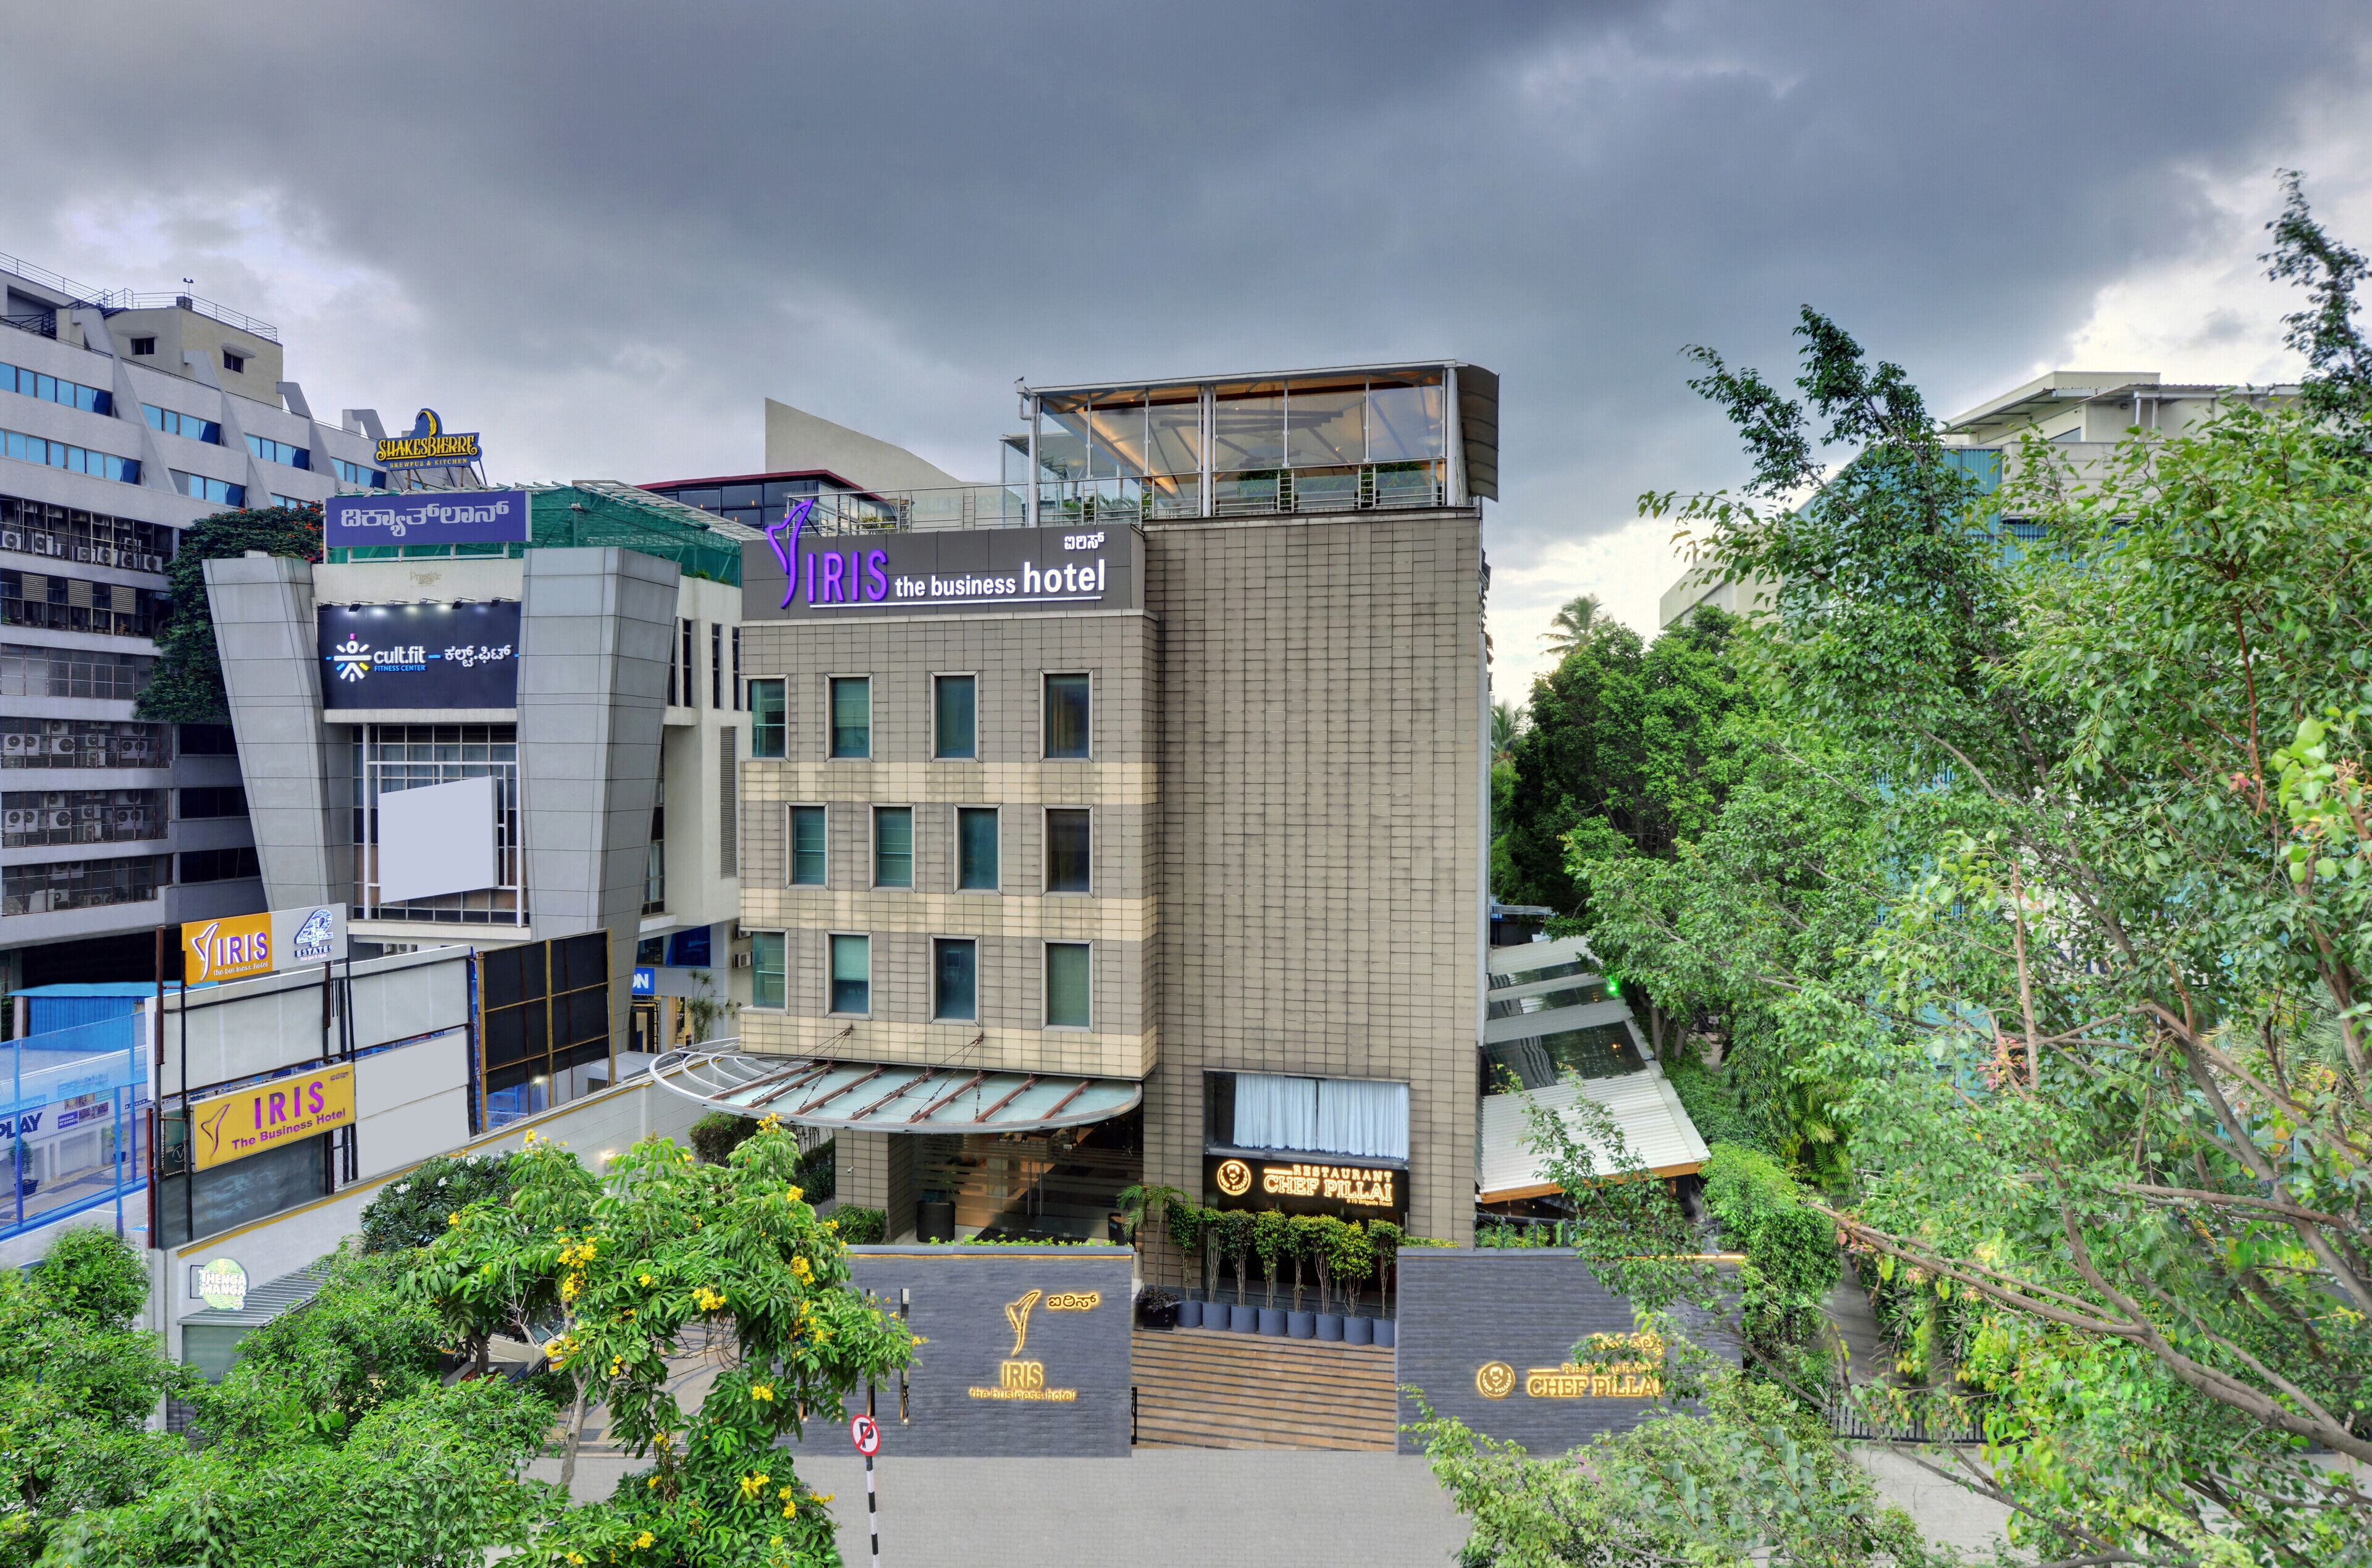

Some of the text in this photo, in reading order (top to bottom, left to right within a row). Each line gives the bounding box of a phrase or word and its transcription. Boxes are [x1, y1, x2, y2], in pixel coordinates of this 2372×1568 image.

[376, 434, 478, 461] SHAKESBIERRE
[434, 458, 468, 466] KITCHEN
[807, 549, 1105, 603] IRIS the business hotel
[373, 645, 426, 665] cult.fit
[216, 931, 268, 967] IRIS
[296, 945, 333, 957] ESTATES
[225, 965, 252, 975] business
[253, 961, 268, 970] hotel
[254, 1081, 324, 1130] IRIS
[232, 1108, 346, 1150] The Business Hotel
[1292, 1164, 1393, 1183] RESTAURANT
[1264, 1174, 1393, 1202] CHEF PILLAI
[198, 1268, 246, 1286] THENGA
[198, 1283, 246, 1296] MANGA
[1048, 1294, 1096, 1308] ಐರಿಸ್
[1003, 1363, 1043, 1388] IRIS
[970, 1388, 1075, 1401] the business hotel
[1529, 1378, 1588, 1396] CHEF
